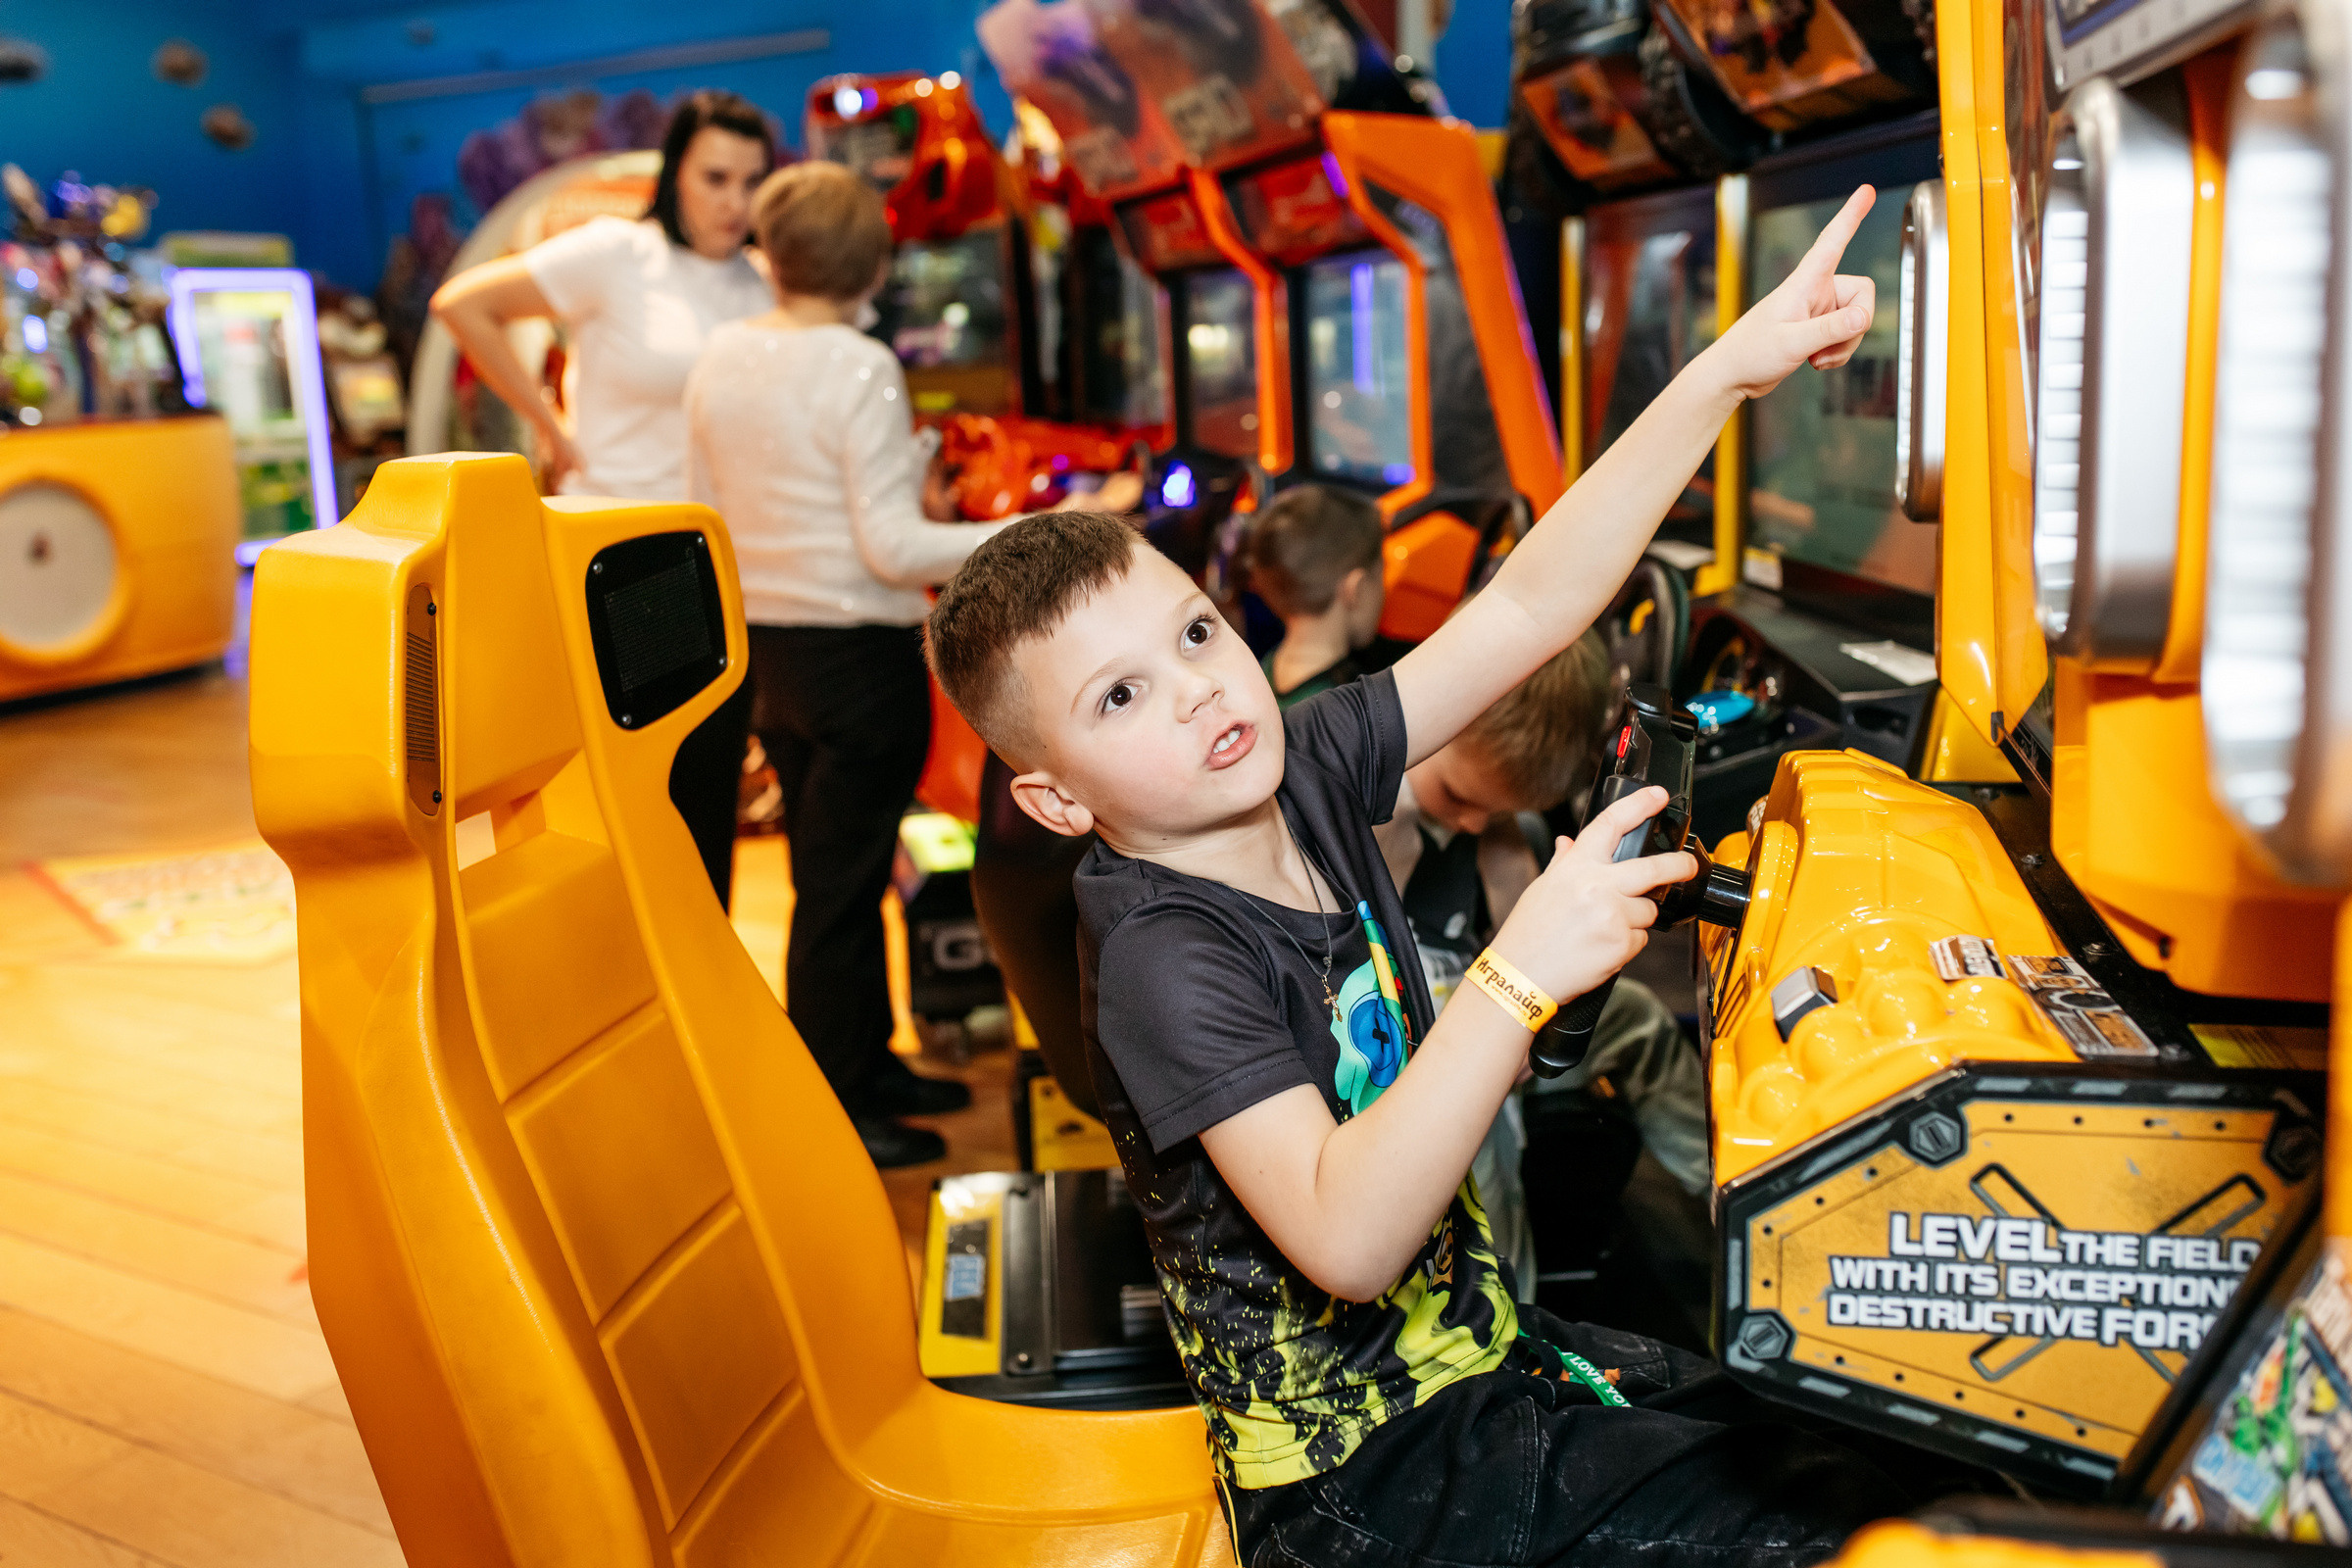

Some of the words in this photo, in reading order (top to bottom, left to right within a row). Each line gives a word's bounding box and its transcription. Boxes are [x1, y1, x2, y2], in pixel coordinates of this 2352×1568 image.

[1476, 957, 1544, 1021] Игралайф
[1890, 1212, 2063, 1262] LEVEL
[2059, 1231, 2140, 1267] THE
[2146, 1235, 2262, 1273] FIELD
[1832, 1257, 1929, 1293] WITH
[1935, 1262, 1999, 1296] ITS
[1829, 1293, 2098, 1339] DESTRUCTIVE
[1569, 1355, 1606, 1385] LOVE
